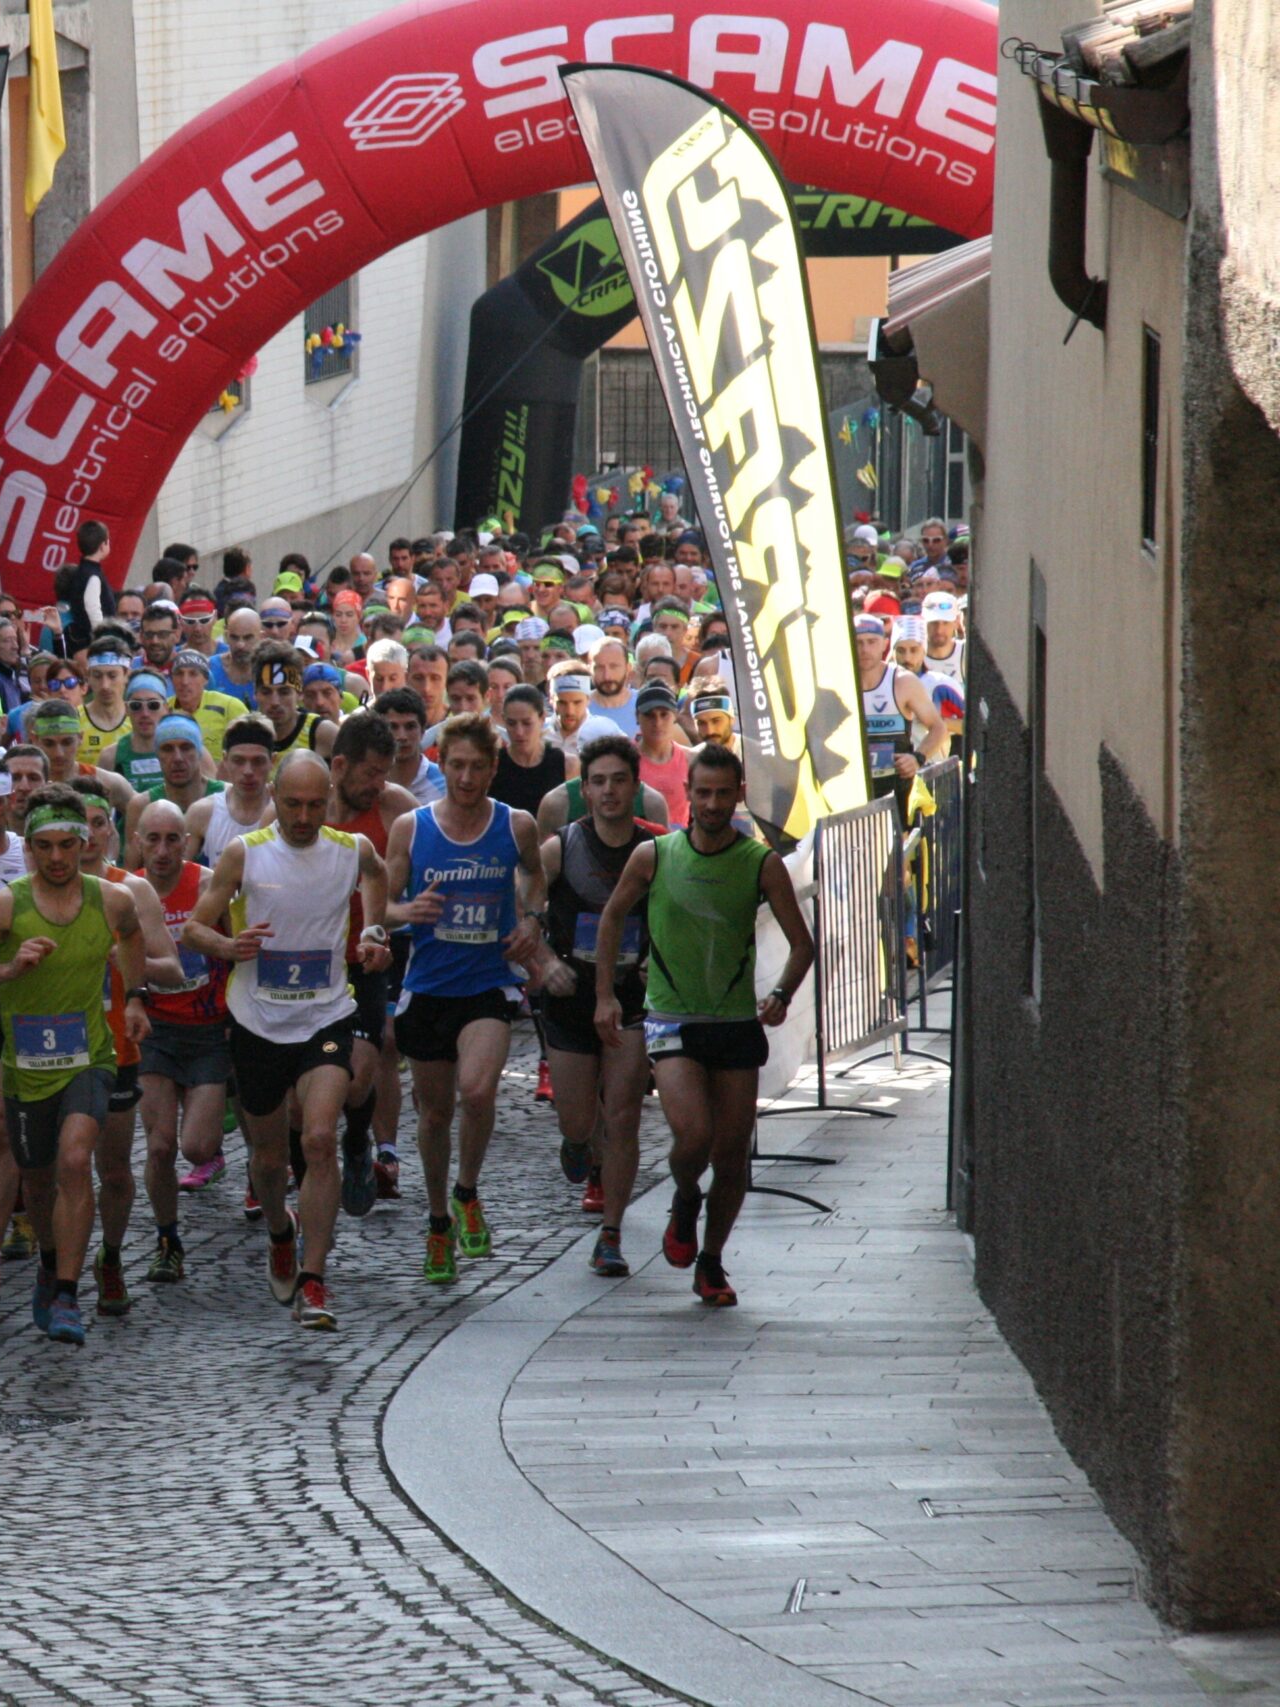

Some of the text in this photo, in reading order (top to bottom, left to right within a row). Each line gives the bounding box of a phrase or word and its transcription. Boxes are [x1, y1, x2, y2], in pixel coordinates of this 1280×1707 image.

[746, 104, 976, 186] solutions
[577, 273, 628, 308] CRAZ
[42, 209, 344, 571] electrical solutions
[424, 865, 507, 882] CorrinTime
[452, 904, 486, 925] 214
[288, 964, 301, 985] 2
[42, 1029, 56, 1050] 3
